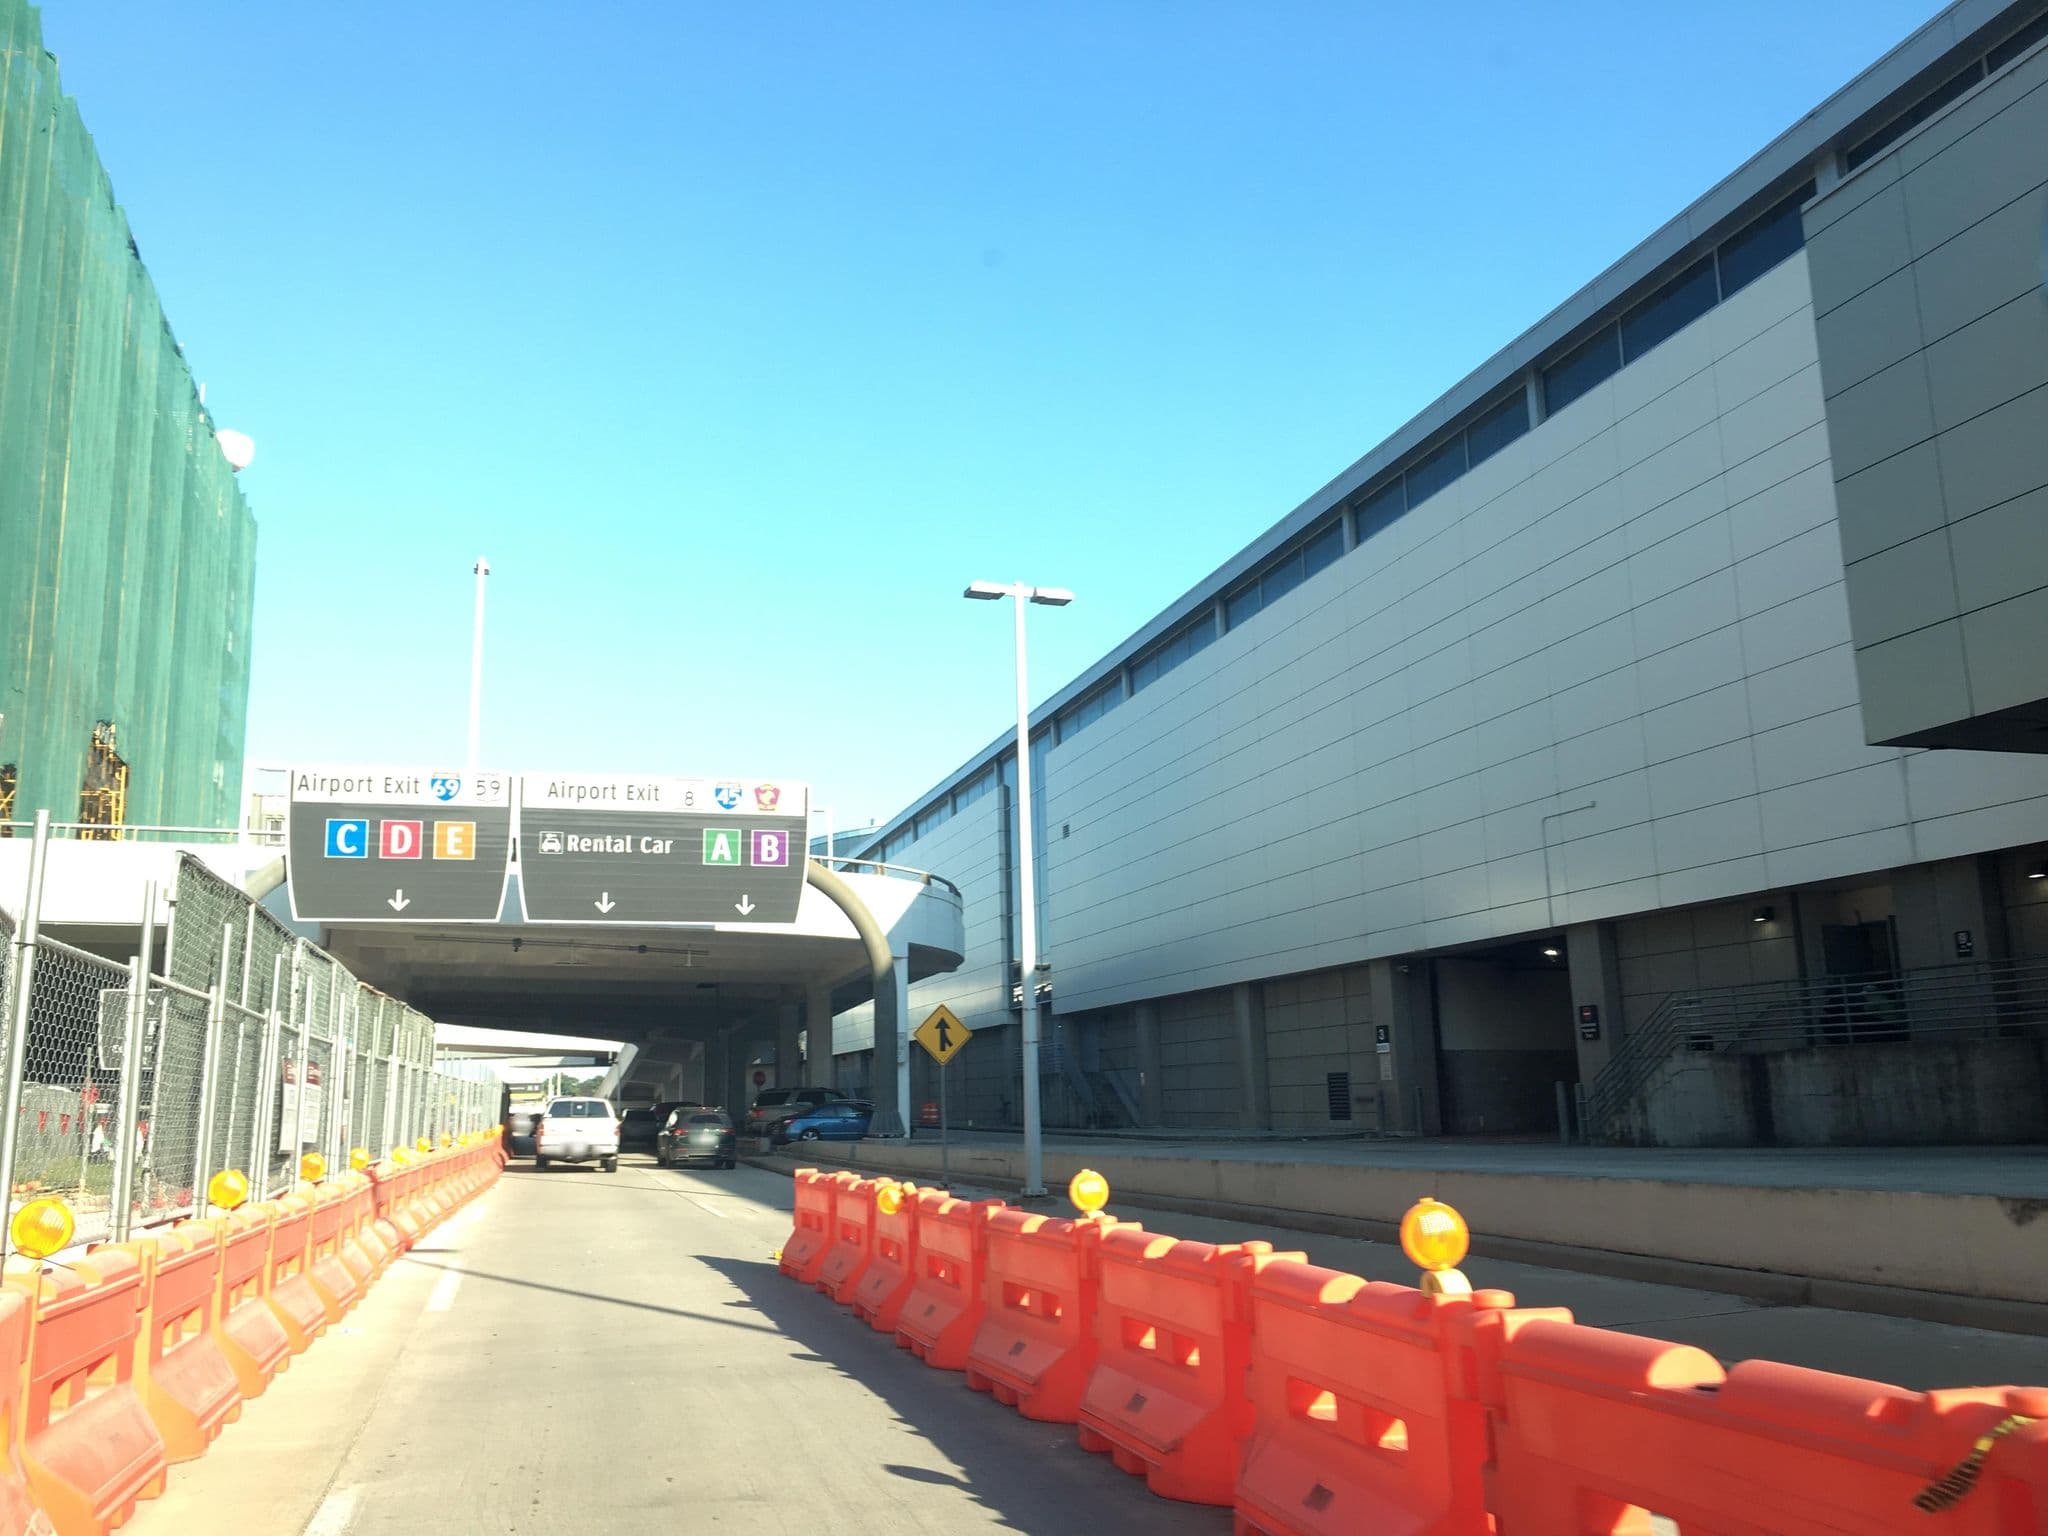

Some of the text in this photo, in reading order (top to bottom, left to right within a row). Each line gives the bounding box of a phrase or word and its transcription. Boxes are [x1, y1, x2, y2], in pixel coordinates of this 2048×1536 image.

[297, 774, 501, 797] Airport Exit 69 59
[547, 781, 741, 807] Airport Exit 8 45
[336, 823, 465, 856] C D E
[567, 833, 780, 863] Rental Car A B
